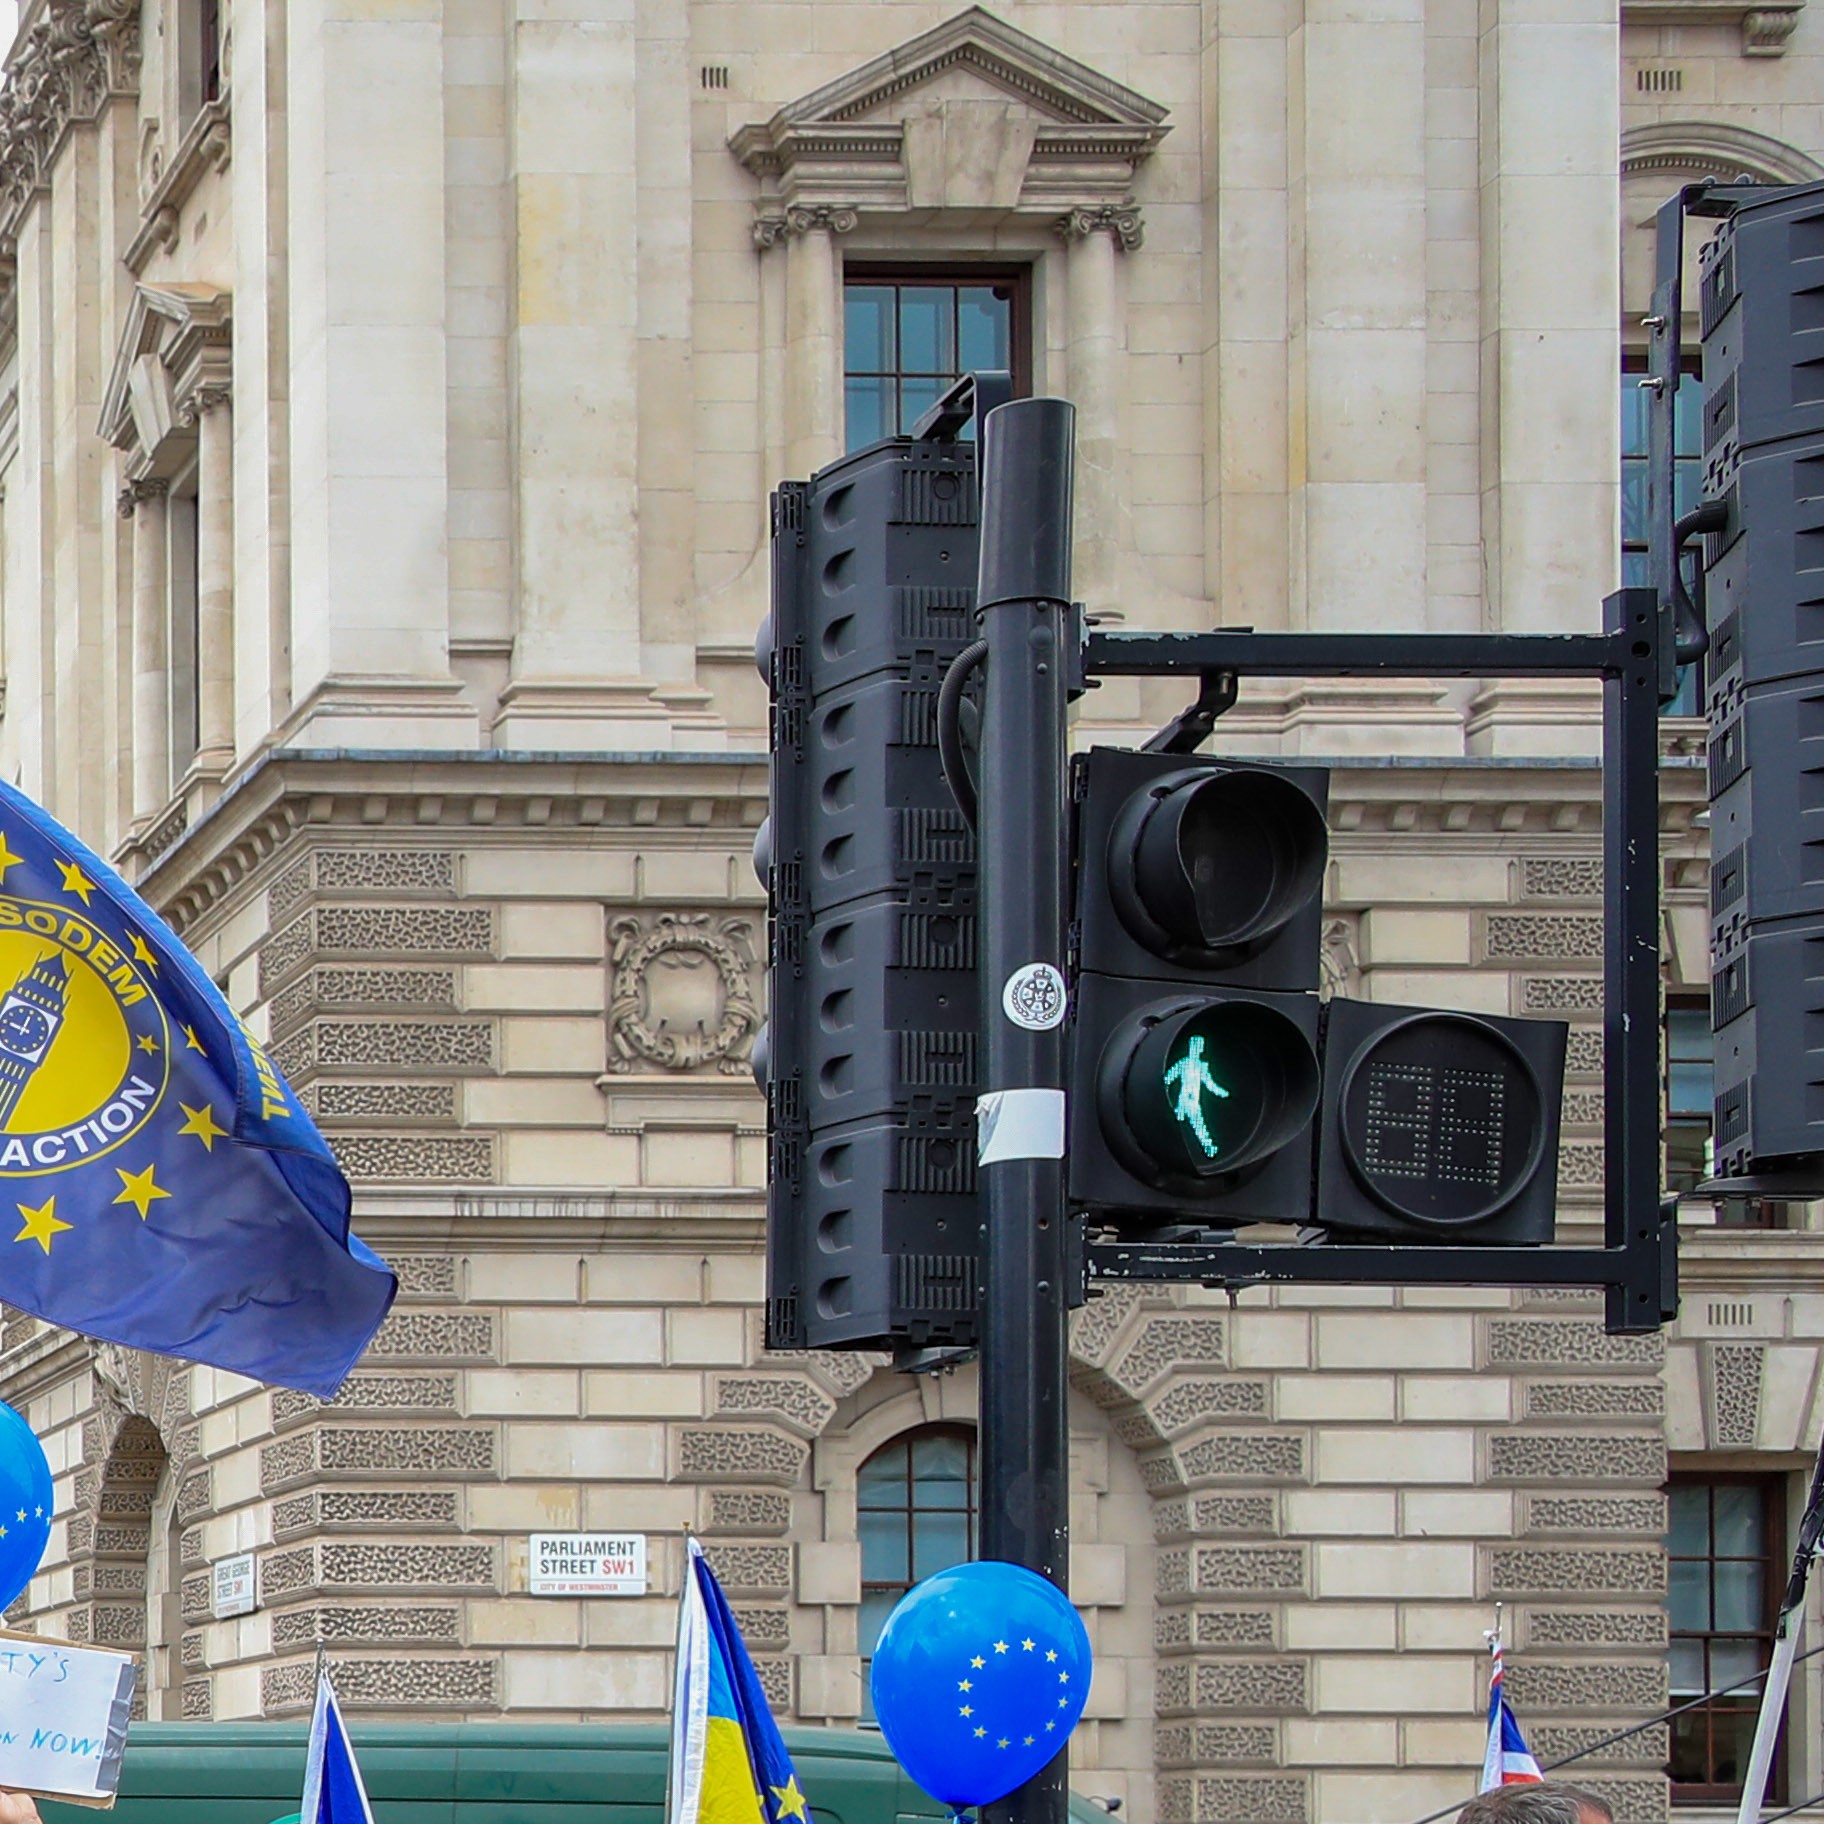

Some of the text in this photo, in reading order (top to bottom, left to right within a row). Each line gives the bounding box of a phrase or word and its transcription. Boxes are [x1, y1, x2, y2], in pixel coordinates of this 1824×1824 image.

[540, 1541, 636, 1556] PARLIAMENT
[540, 1559, 635, 1575] STREET SW1
